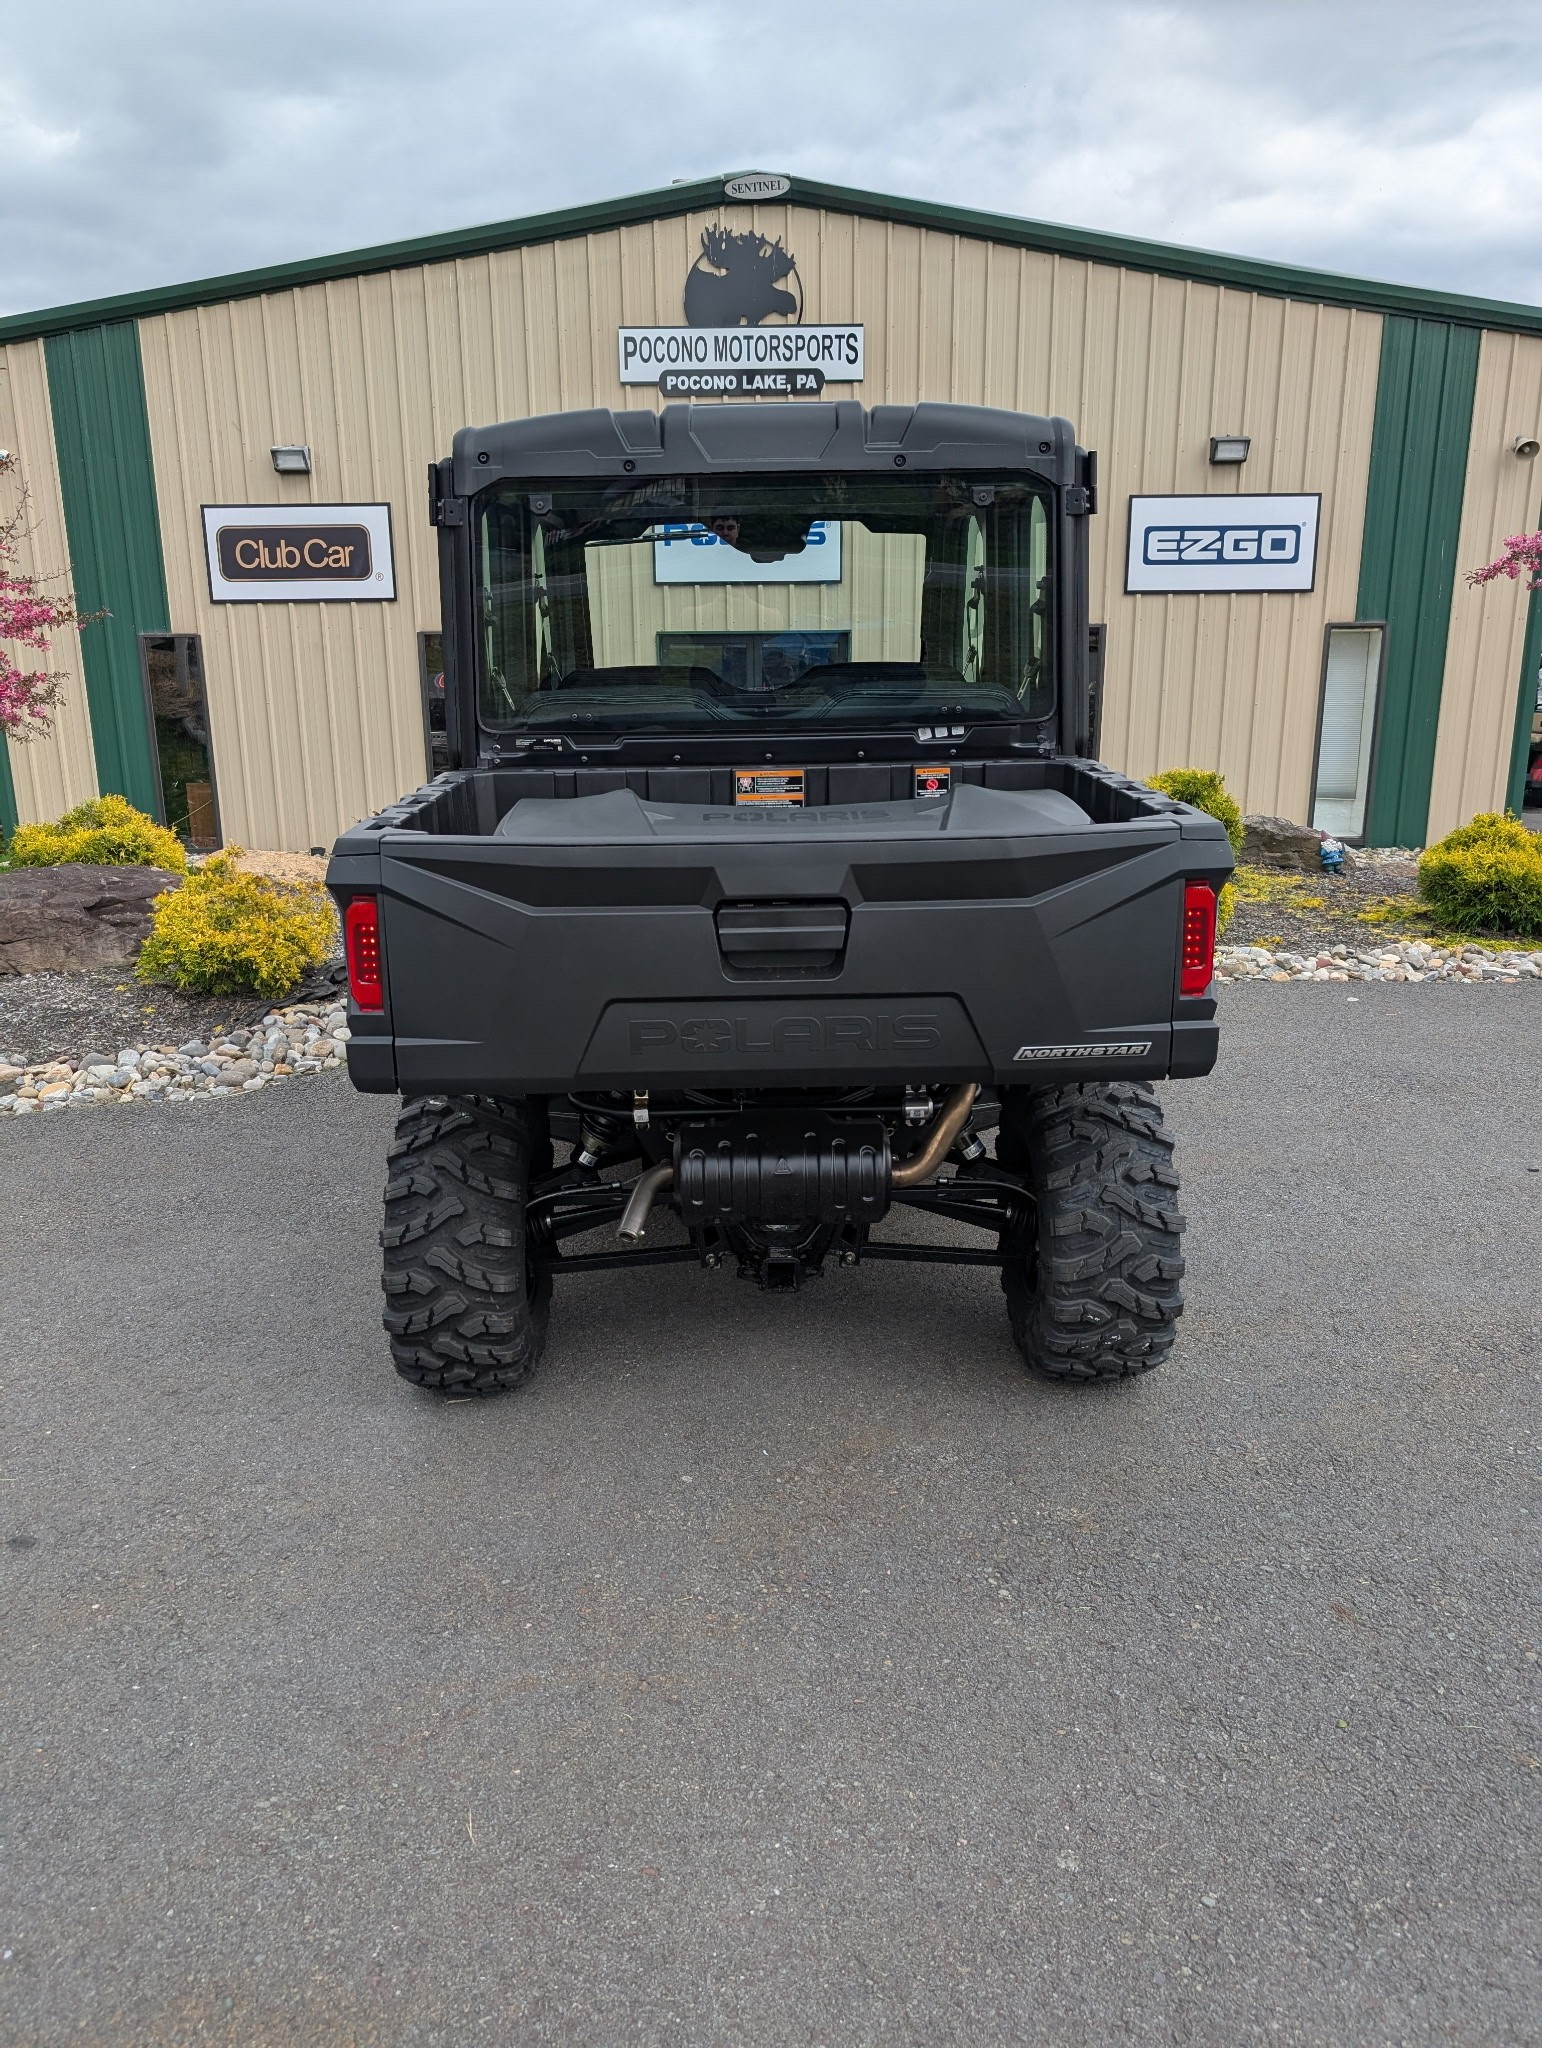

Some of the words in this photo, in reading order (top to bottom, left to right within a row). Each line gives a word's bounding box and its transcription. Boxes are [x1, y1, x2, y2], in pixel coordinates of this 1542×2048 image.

[731, 180, 785, 195] SENTINEL
[623, 335, 708, 370] POCONO
[714, 332, 859, 365] MOTORSPORTS
[666, 375, 737, 390] POCONO
[742, 375, 792, 393] LAKE,
[796, 374, 818, 389] PA
[235, 539, 301, 569] Club
[303, 538, 354, 568] Car
[702, 809, 890, 823] POLARIS
[629, 1014, 942, 1055] POLARIS
[1020, 1045, 1145, 1059] NORTHSTAR
